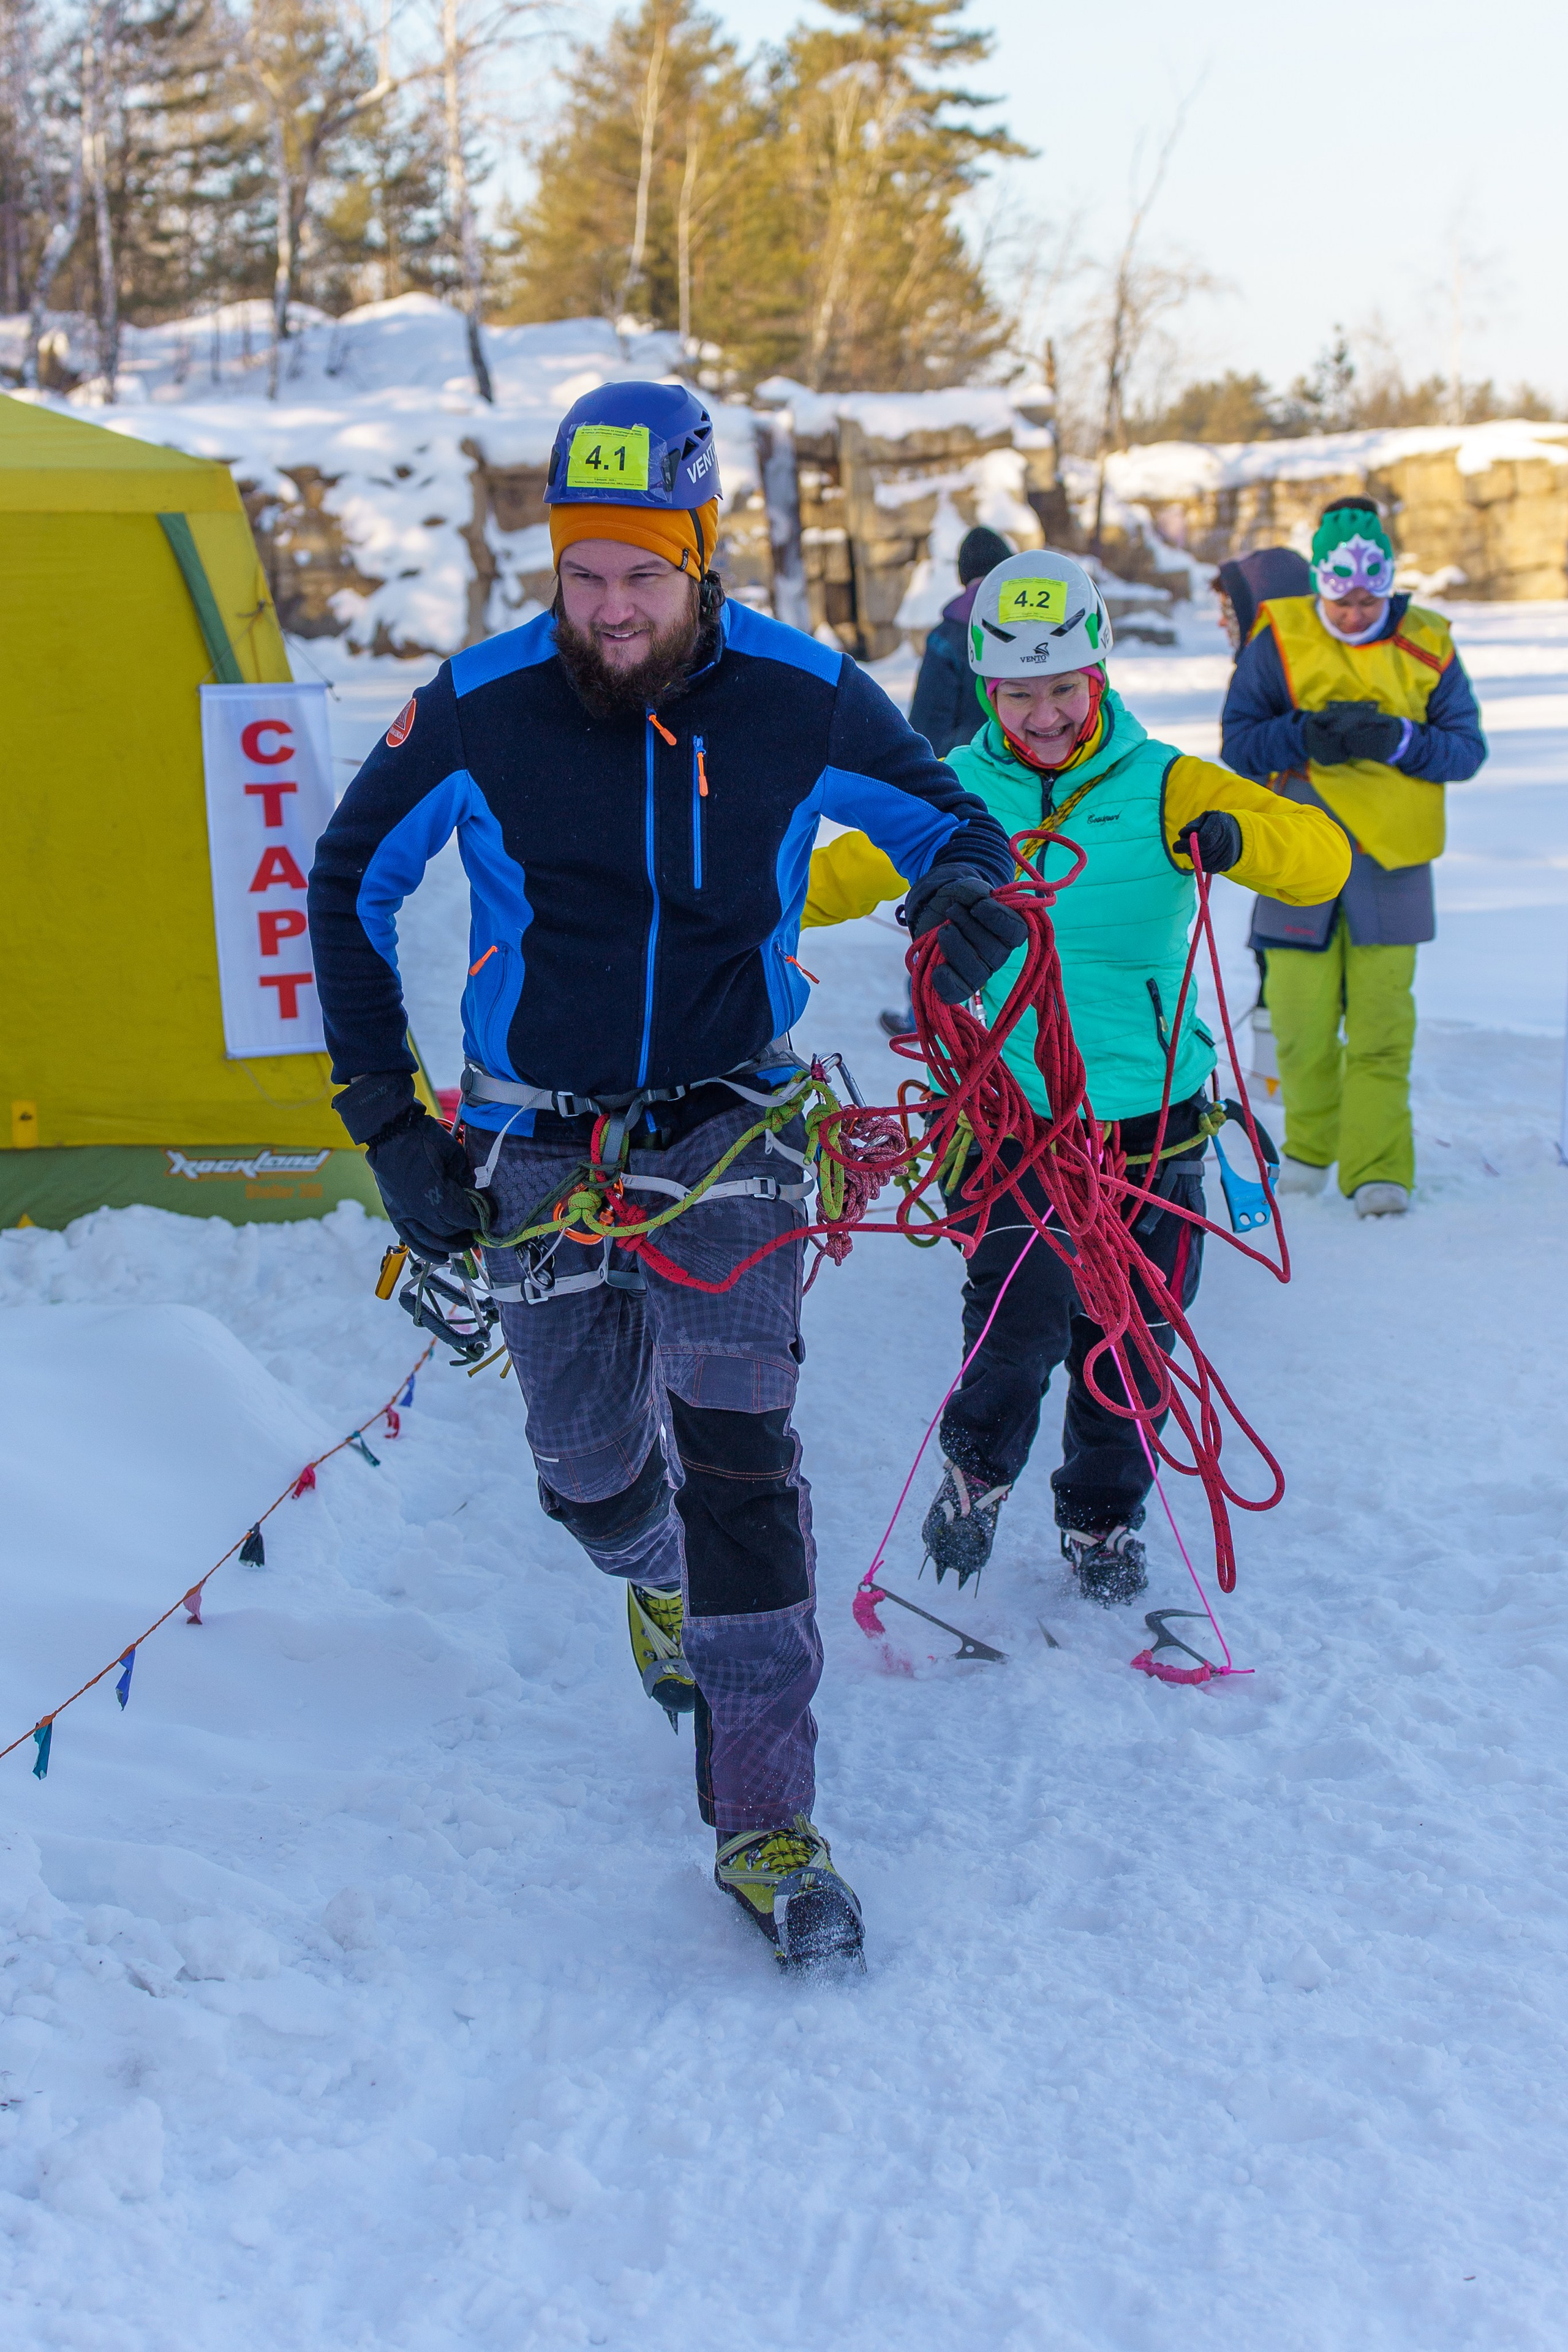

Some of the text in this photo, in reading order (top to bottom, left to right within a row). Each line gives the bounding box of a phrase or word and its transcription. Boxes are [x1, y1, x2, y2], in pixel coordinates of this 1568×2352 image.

[585, 445, 626, 471] 4.1
[1014, 590, 1050, 609] 4.2
[241, 719, 313, 1019] СТАРТ
